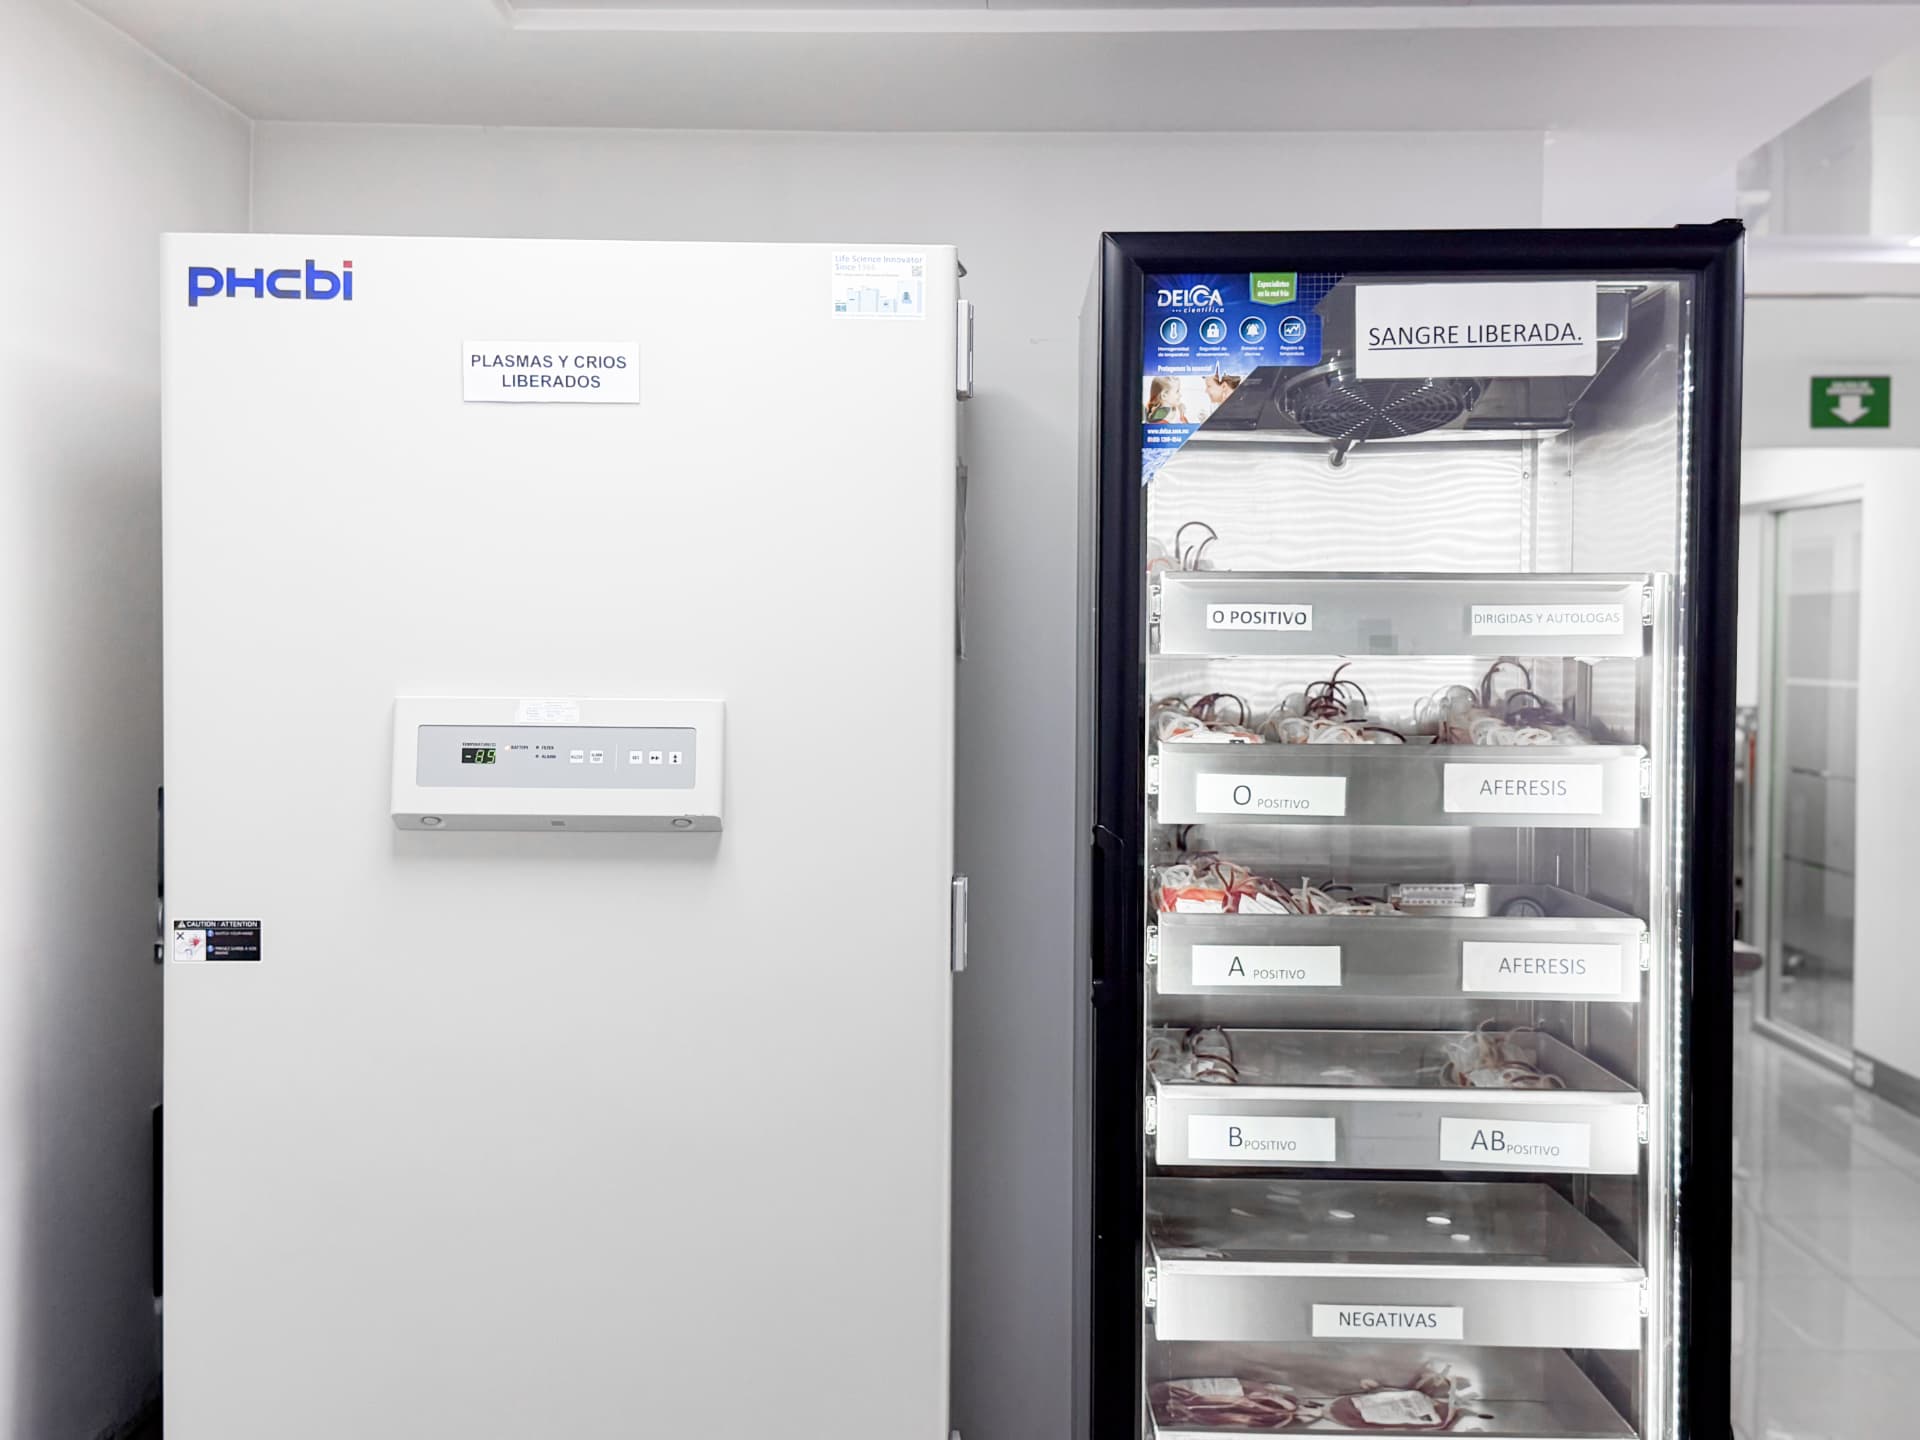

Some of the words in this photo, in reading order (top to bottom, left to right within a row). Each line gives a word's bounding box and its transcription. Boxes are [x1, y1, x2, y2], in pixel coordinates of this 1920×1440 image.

[852, 255, 882, 264] Science
[883, 255, 923, 265] Innovator
[1158, 285, 1223, 307] DELCA
[1368, 325, 1459, 347] SANGRE
[1467, 322, 1583, 344] LIBERADA.
[471, 355, 553, 368] PLASMAS
[558, 355, 569, 368] Y
[574, 355, 627, 369] CRIOS
[502, 374, 601, 388] LIBERADOS
[1212, 610, 1225, 624] O
[1230, 611, 1307, 625] POSITIVO
[1474, 613, 1533, 624] DIRIGIDAS
[1535, 613, 1543, 623] Y
[1546, 612, 1620, 624] AUTOLOGAS
[1480, 779, 1567, 796] AFERESIS
[1233, 785, 1251, 805] O
[1257, 798, 1310, 809] POSITIVO
[1228, 956, 1245, 976] A
[1253, 969, 1306, 980] POSITIVO
[1498, 957, 1586, 974] AFERESIS
[1339, 1311, 1437, 1328] NEGATIVAS
